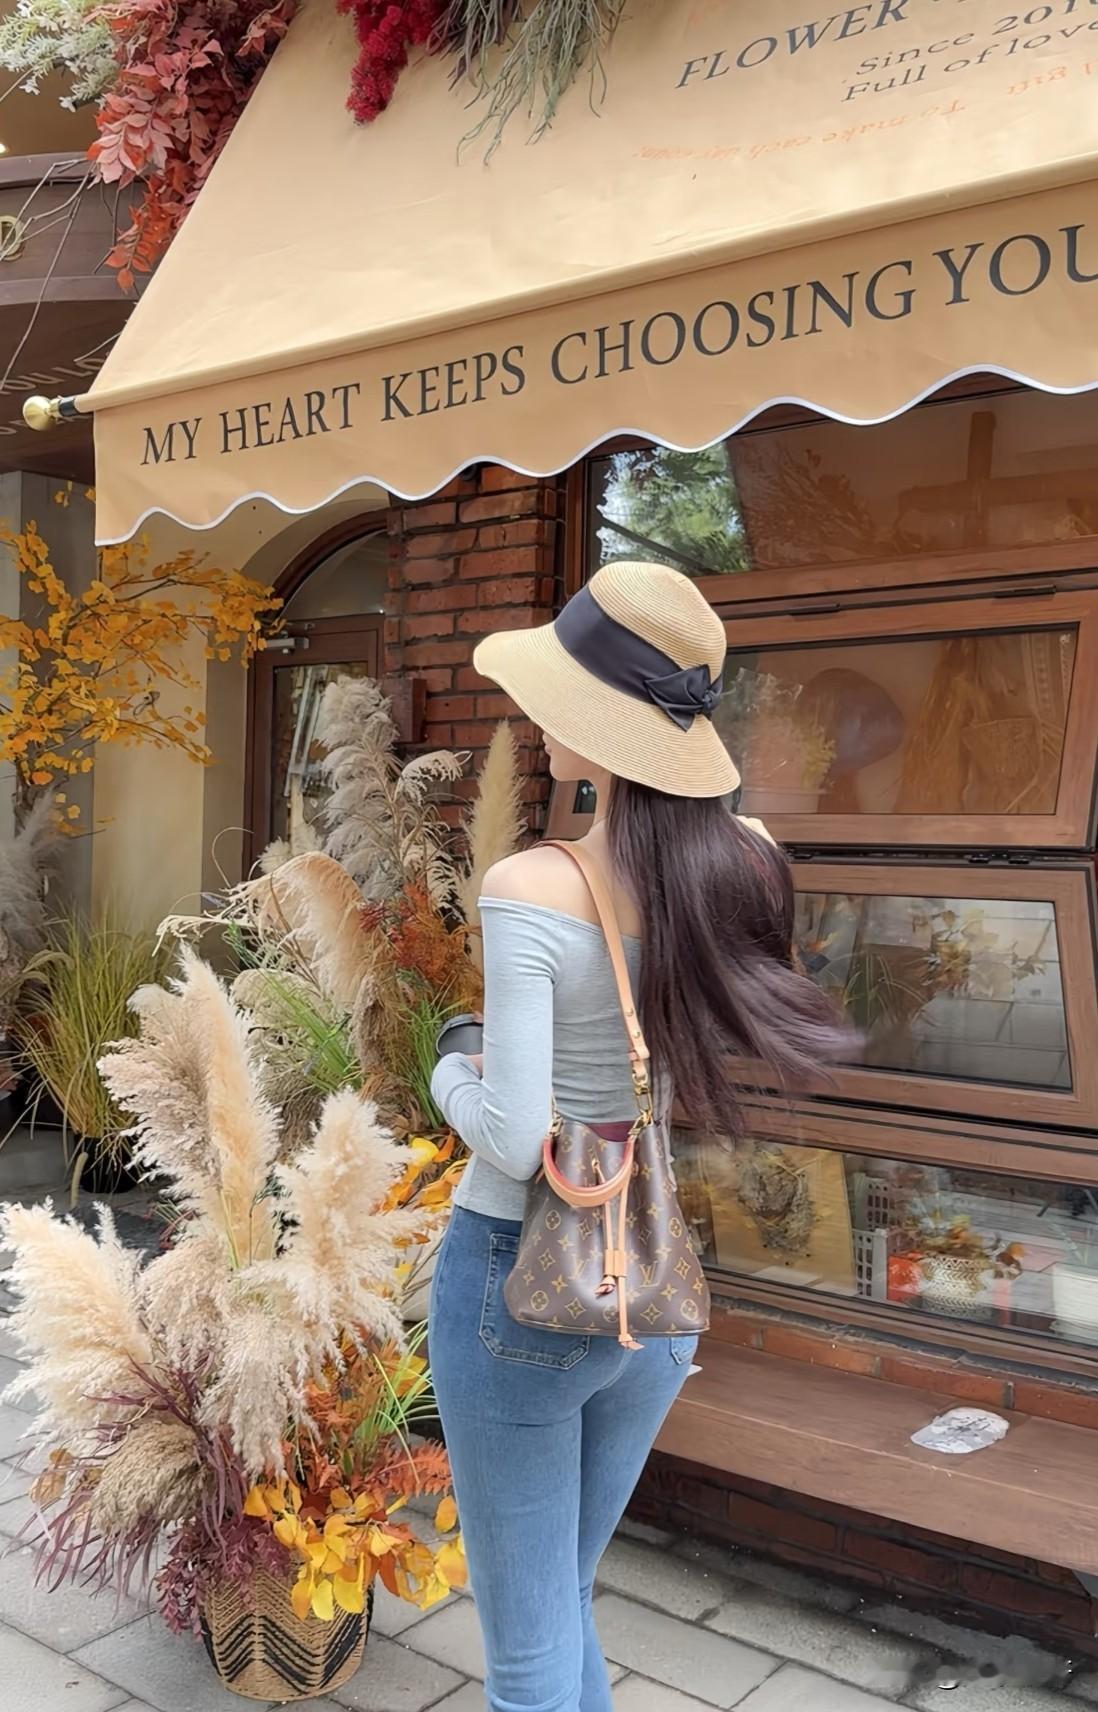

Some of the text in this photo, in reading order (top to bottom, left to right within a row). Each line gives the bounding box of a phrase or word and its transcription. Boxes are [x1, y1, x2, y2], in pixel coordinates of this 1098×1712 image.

[674, 0, 908, 89] FLOWER
[841, 65, 926, 103] Full
[943, 44, 1000, 72] of
[856, 0, 1098, 75] Since 201
[140, 417, 203, 466] MY
[218, 382, 361, 454] HEART
[380, 344, 526, 422] KEEPS
[550, 259, 918, 385] CHOOSING
